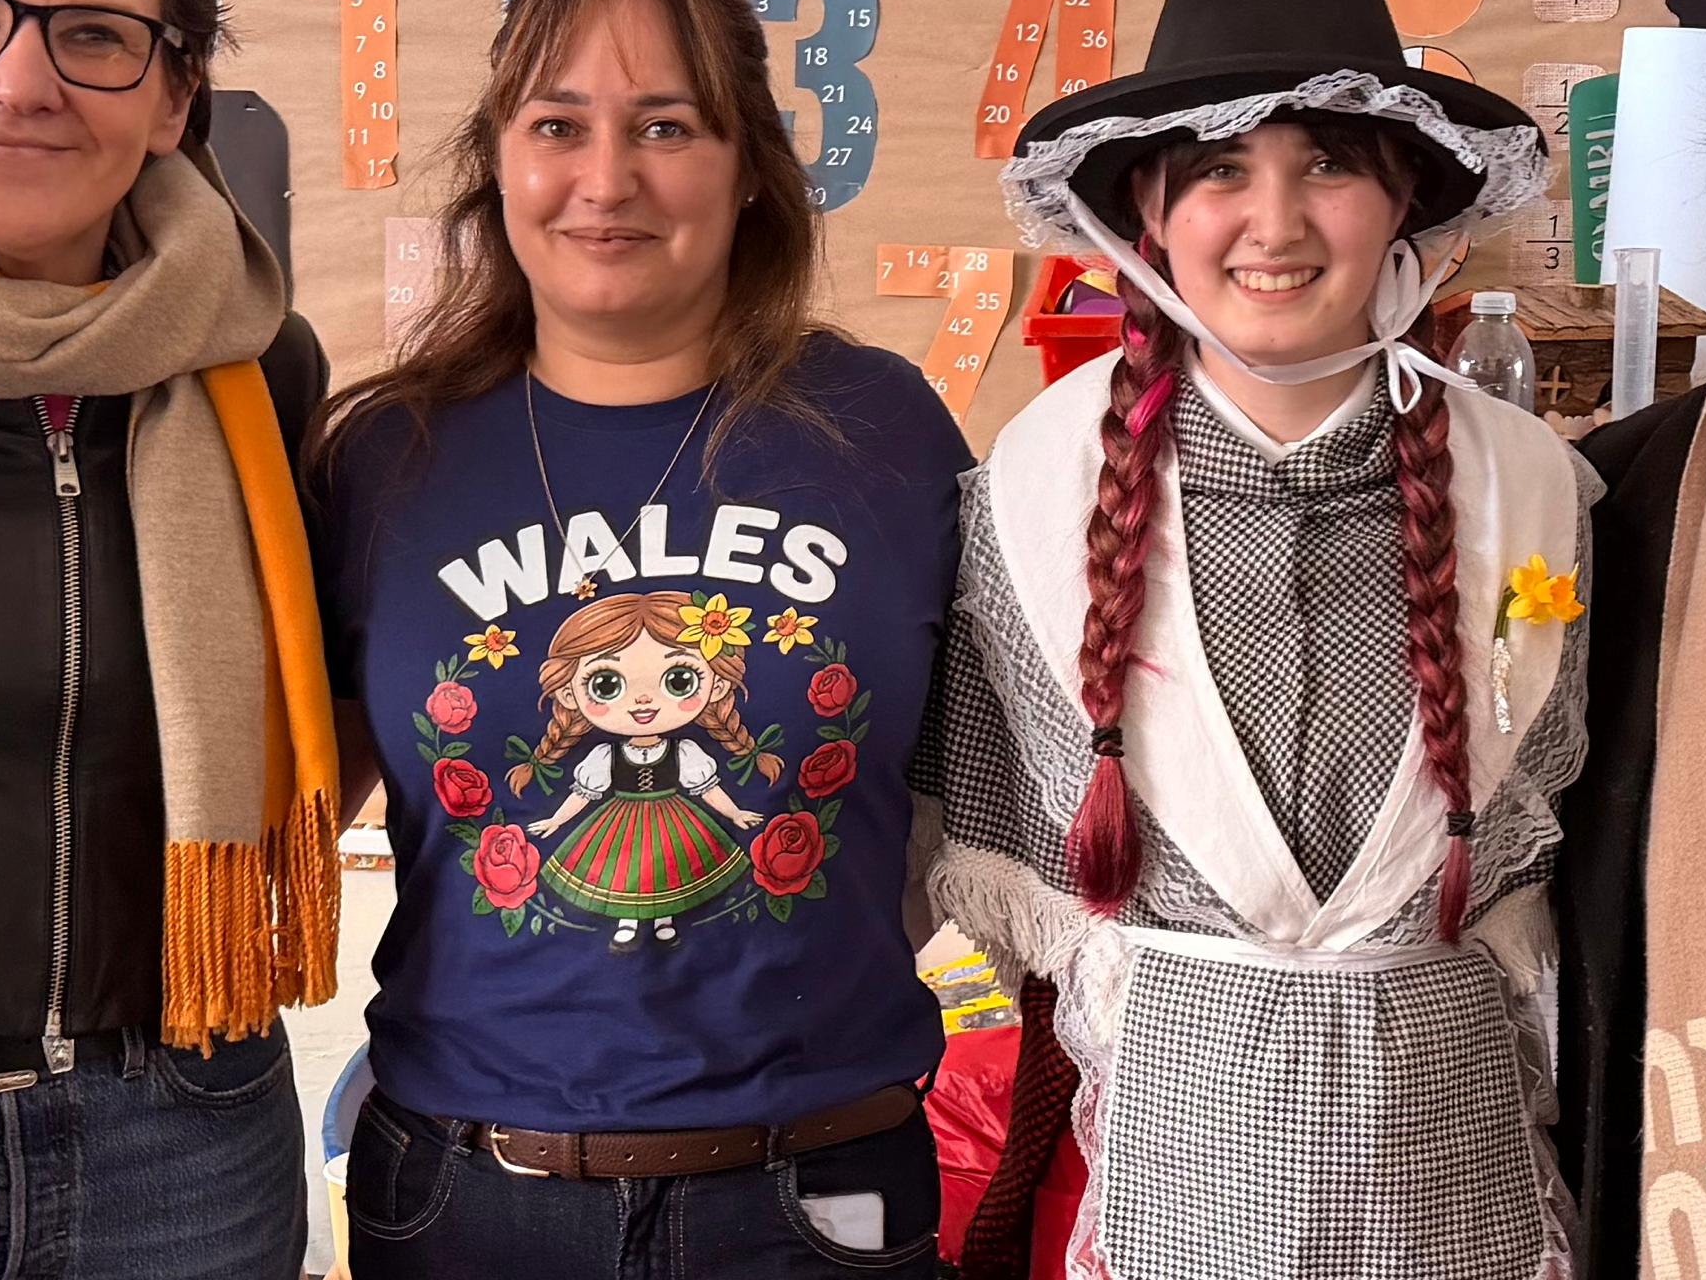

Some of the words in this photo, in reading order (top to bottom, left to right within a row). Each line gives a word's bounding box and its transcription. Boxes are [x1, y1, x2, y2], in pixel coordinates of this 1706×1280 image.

[373, 15, 386, 33] 6
[848, 9, 871, 27] 15
[1016, 23, 1040, 42] 12
[1081, 30, 1108, 49] 36
[355, 36, 367, 54] 7
[804, 47, 828, 66] 18
[373, 61, 386, 80] 8
[995, 63, 1019, 82] 16
[353, 82, 366, 100] 9
[821, 85, 844, 103] 21
[1560, 79, 1569, 103] 1
[371, 102, 394, 120] 10
[984, 105, 1010, 124] 20
[847, 116, 873, 135] 24
[1554, 111, 1569, 136] 2
[348, 128, 369, 145] 11
[826, 148, 852, 166] 27
[1549, 214, 1558, 238] 1
[397, 243, 420, 261] 15
[906, 250, 930, 268] 14
[1544, 246, 1560, 270] 3
[881, 262, 892, 280] 7
[964, 253, 988, 272] 28
[937, 270, 960, 289] 21
[388, 286, 414, 304] 20
[975, 293, 1000, 311] 35
[948, 318, 973, 336] 42
[954, 354, 980, 373] 49
[437, 504, 848, 622] WALES
